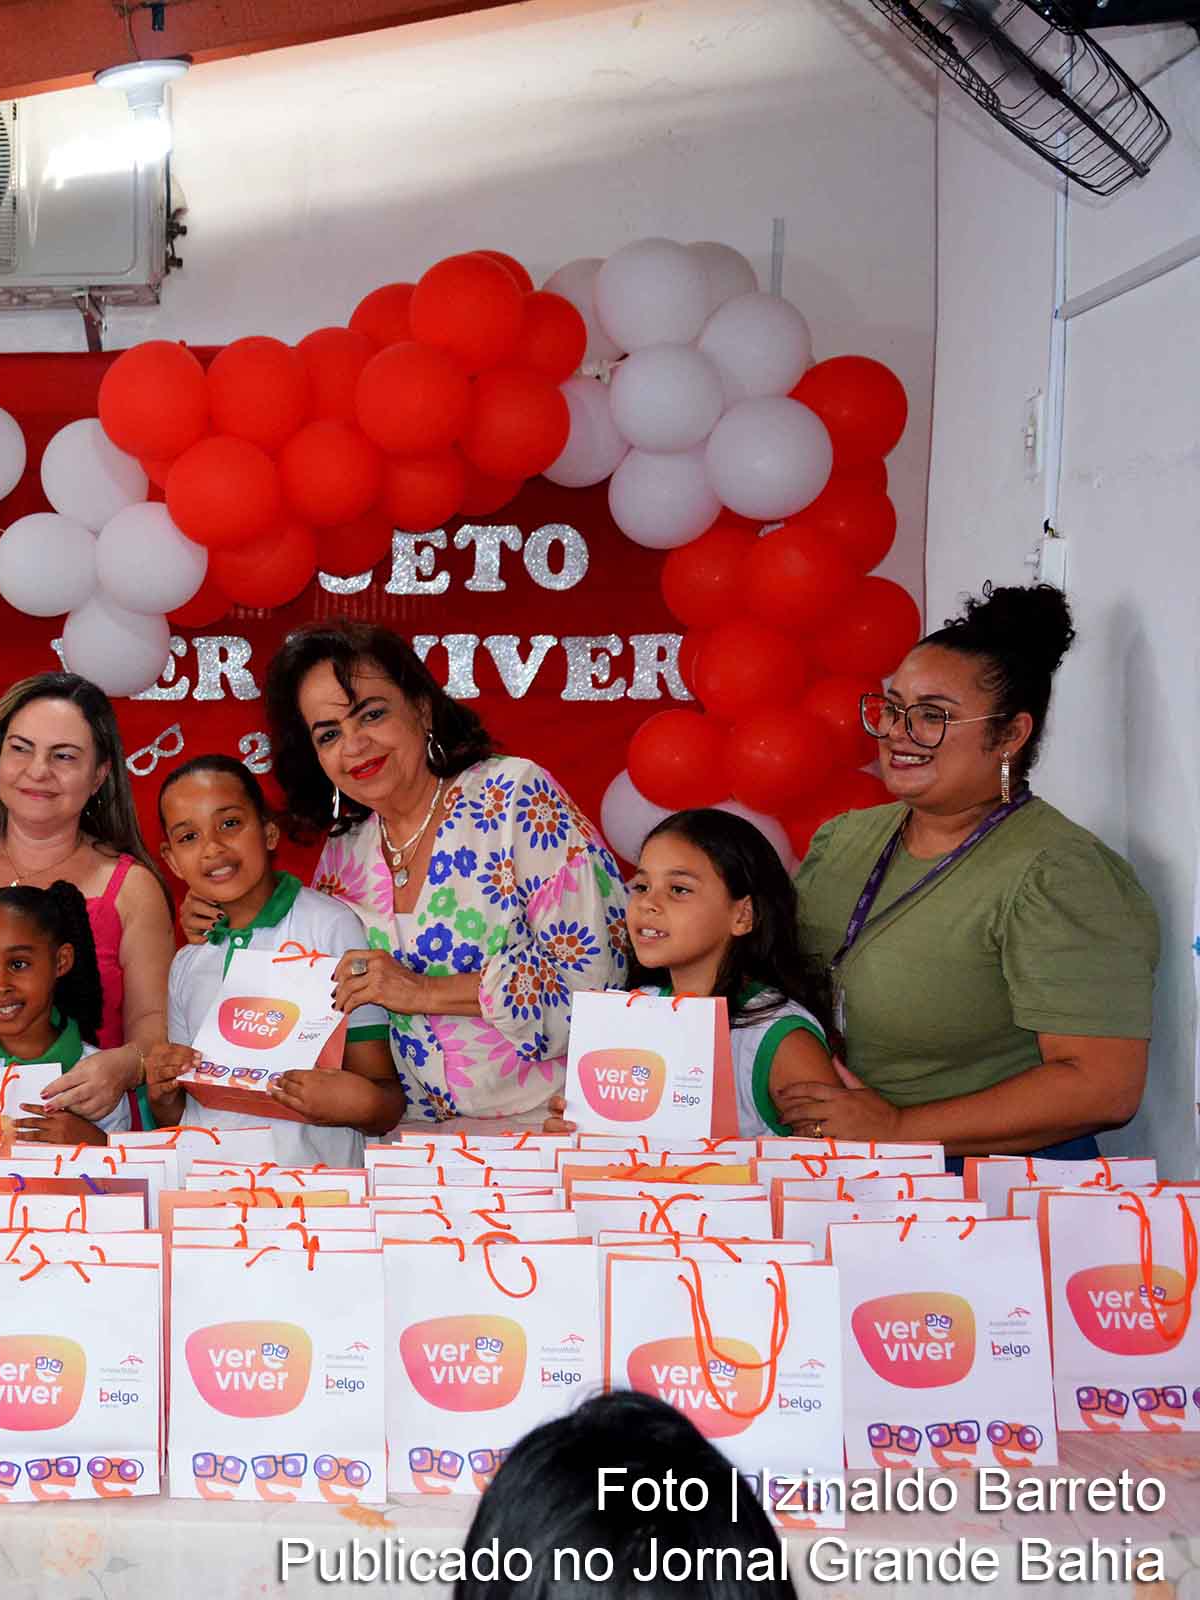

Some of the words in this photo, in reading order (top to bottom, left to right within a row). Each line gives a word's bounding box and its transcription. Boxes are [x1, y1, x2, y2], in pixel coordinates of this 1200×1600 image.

[318, 523, 589, 595] ETO
[233, 1008, 264, 1023] ver
[232, 1019, 279, 1038] viver
[594, 1067, 628, 1083] ver
[598, 1085, 649, 1103] viver
[673, 1091, 700, 1106] belgo
[1088, 1290, 1135, 1309] ver
[874, 1319, 920, 1340] ver
[207, 1347, 257, 1369] ver
[422, 1343, 470, 1363] ver
[883, 1341, 955, 1361] viver
[991, 1341, 1031, 1357] belgo
[214, 1371, 289, 1391] viver
[325, 1374, 365, 1392] belgo
[429, 1365, 504, 1385] viver
[541, 1368, 581, 1385] belgo
[650, 1364, 702, 1386] ver
[99, 1388, 139, 1405] belgo
[778, 1392, 822, 1412] belgo
